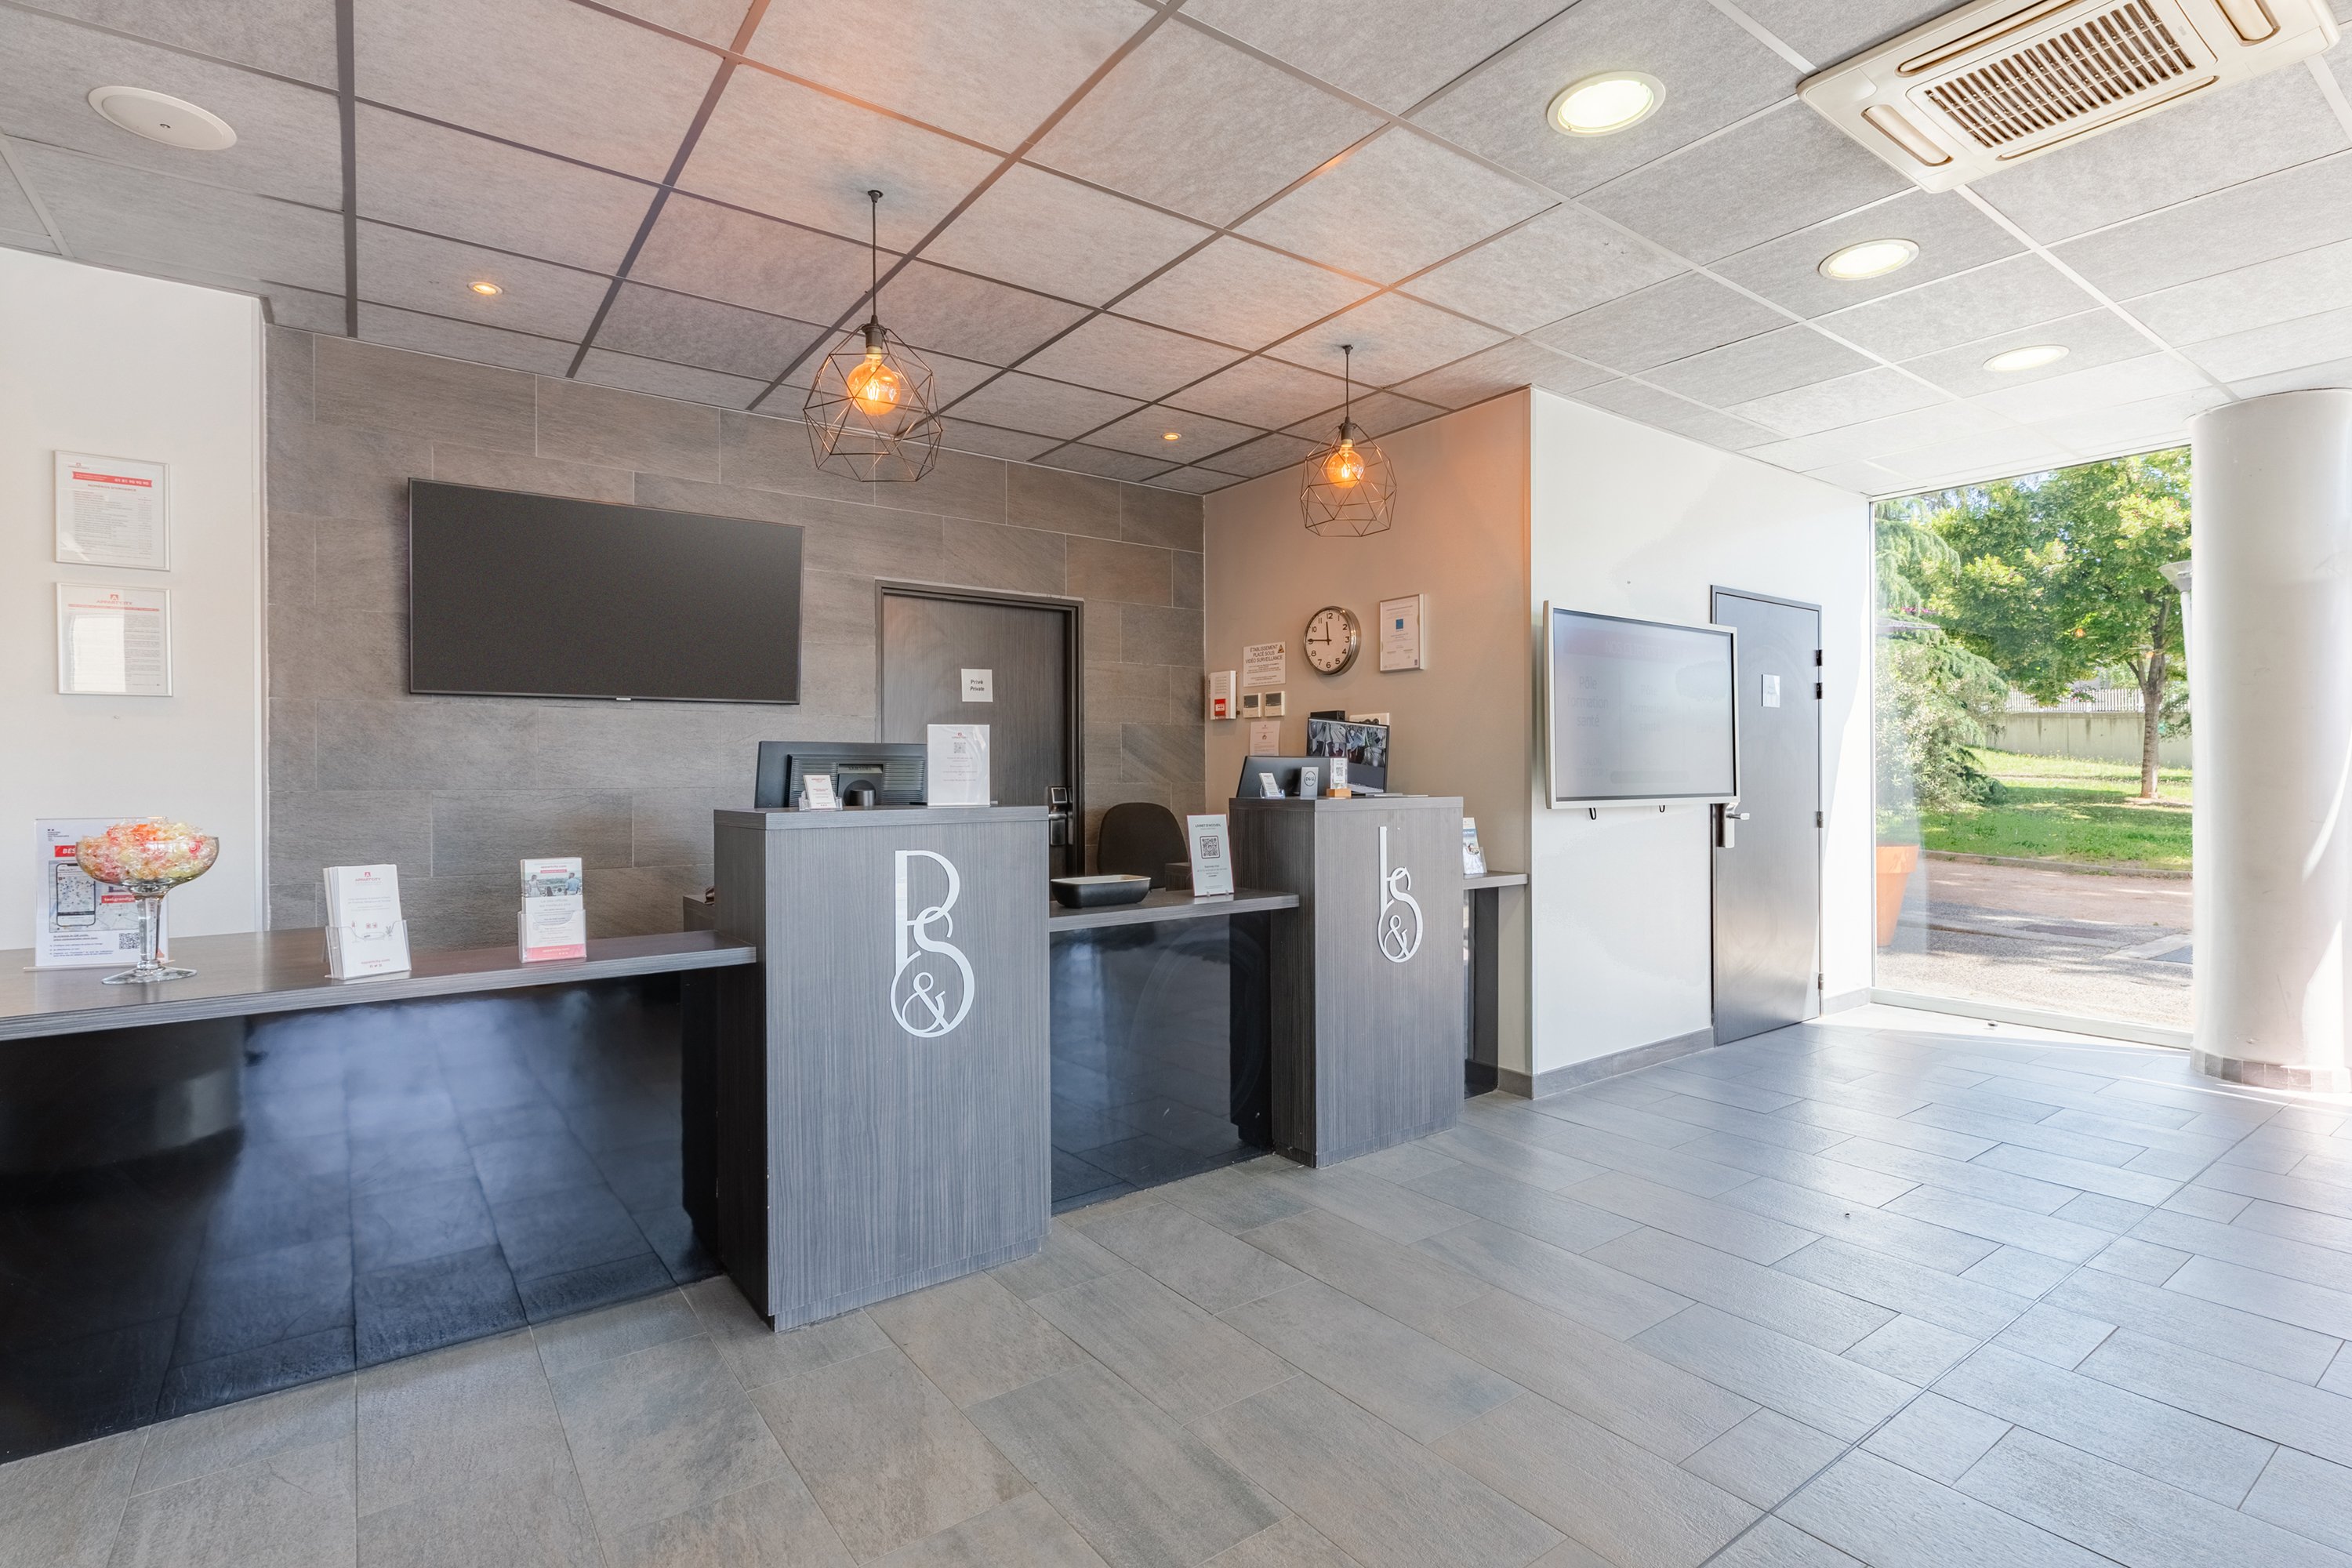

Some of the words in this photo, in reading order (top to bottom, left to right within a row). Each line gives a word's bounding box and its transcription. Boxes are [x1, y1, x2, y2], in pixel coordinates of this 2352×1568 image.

[1250, 644, 1278, 652] ÉTABLISSEMENT
[1257, 655, 1283, 663] SURVEILLANCE
[1579, 676, 1597, 690] Pôle
[1567, 694, 1609, 710] formation
[1577, 714, 1599, 728] santé
